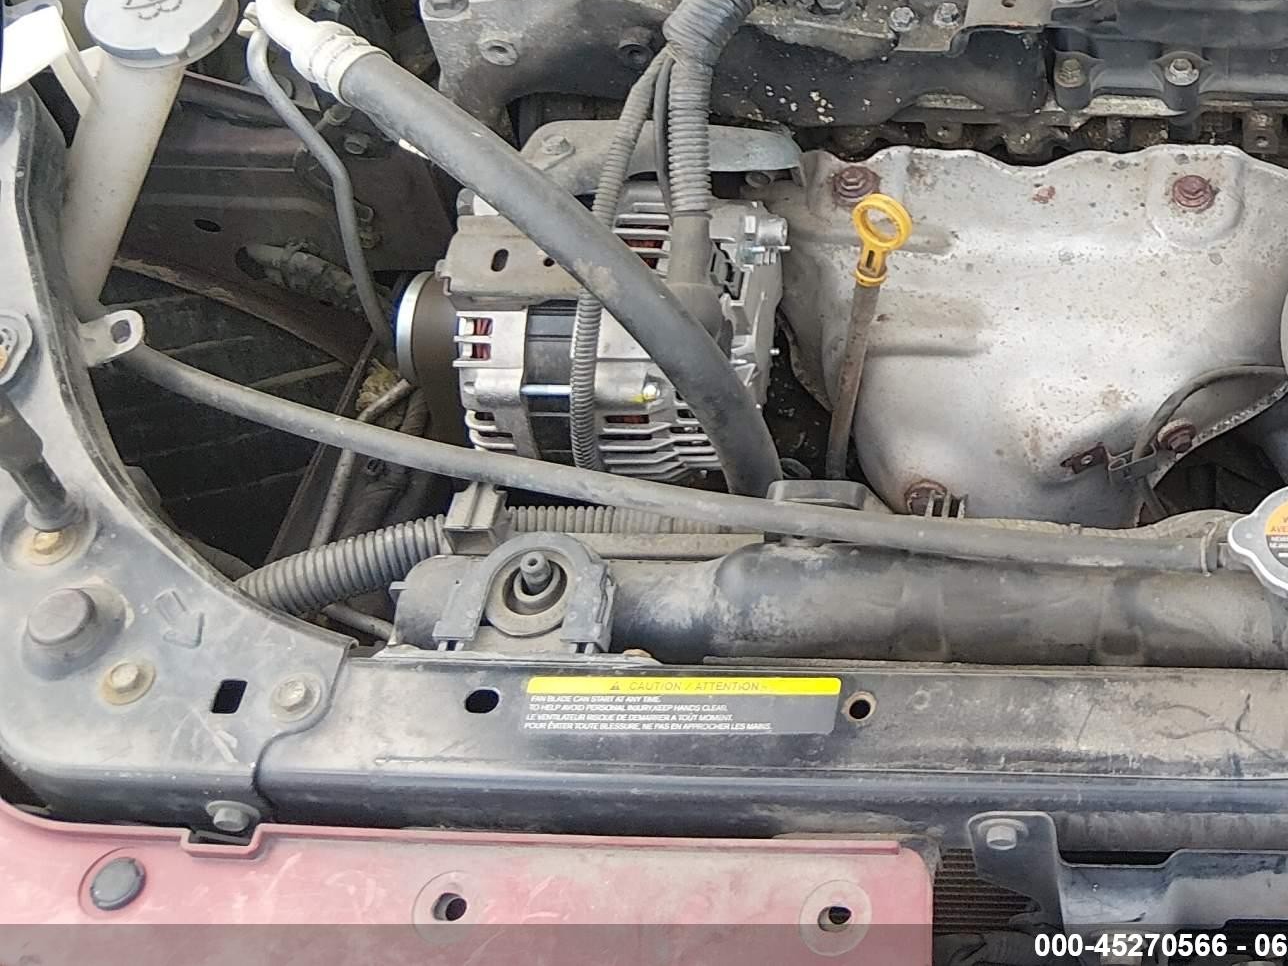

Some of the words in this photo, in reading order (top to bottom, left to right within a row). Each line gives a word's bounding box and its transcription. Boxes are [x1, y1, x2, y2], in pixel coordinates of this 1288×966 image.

[629, 681, 682, 691] CAUTION
[694, 681, 760, 691] ATTENTION
[530, 695, 546, 703] FAN
[547, 695, 572, 703] BLADE
[573, 695, 589, 703] CAN
[591, 695, 613, 703] START
[615, 695, 625, 703] AT
[626, 695, 642, 703] ANY
[529, 704, 540, 712] TO
[541, 704, 562, 712] HELP
[561, 704, 585, 712] AVOID
[586, 704, 626, 712] PERSONAL
[673, 704, 700, 712] HANDS
[526, 713, 537, 721] LE
[537, 713, 585, 721] VENTILATEUR
[586, 713, 616, 721] RISQUE
[524, 722, 546, 730] POUR
[574, 722, 599, 730] TOUTE
